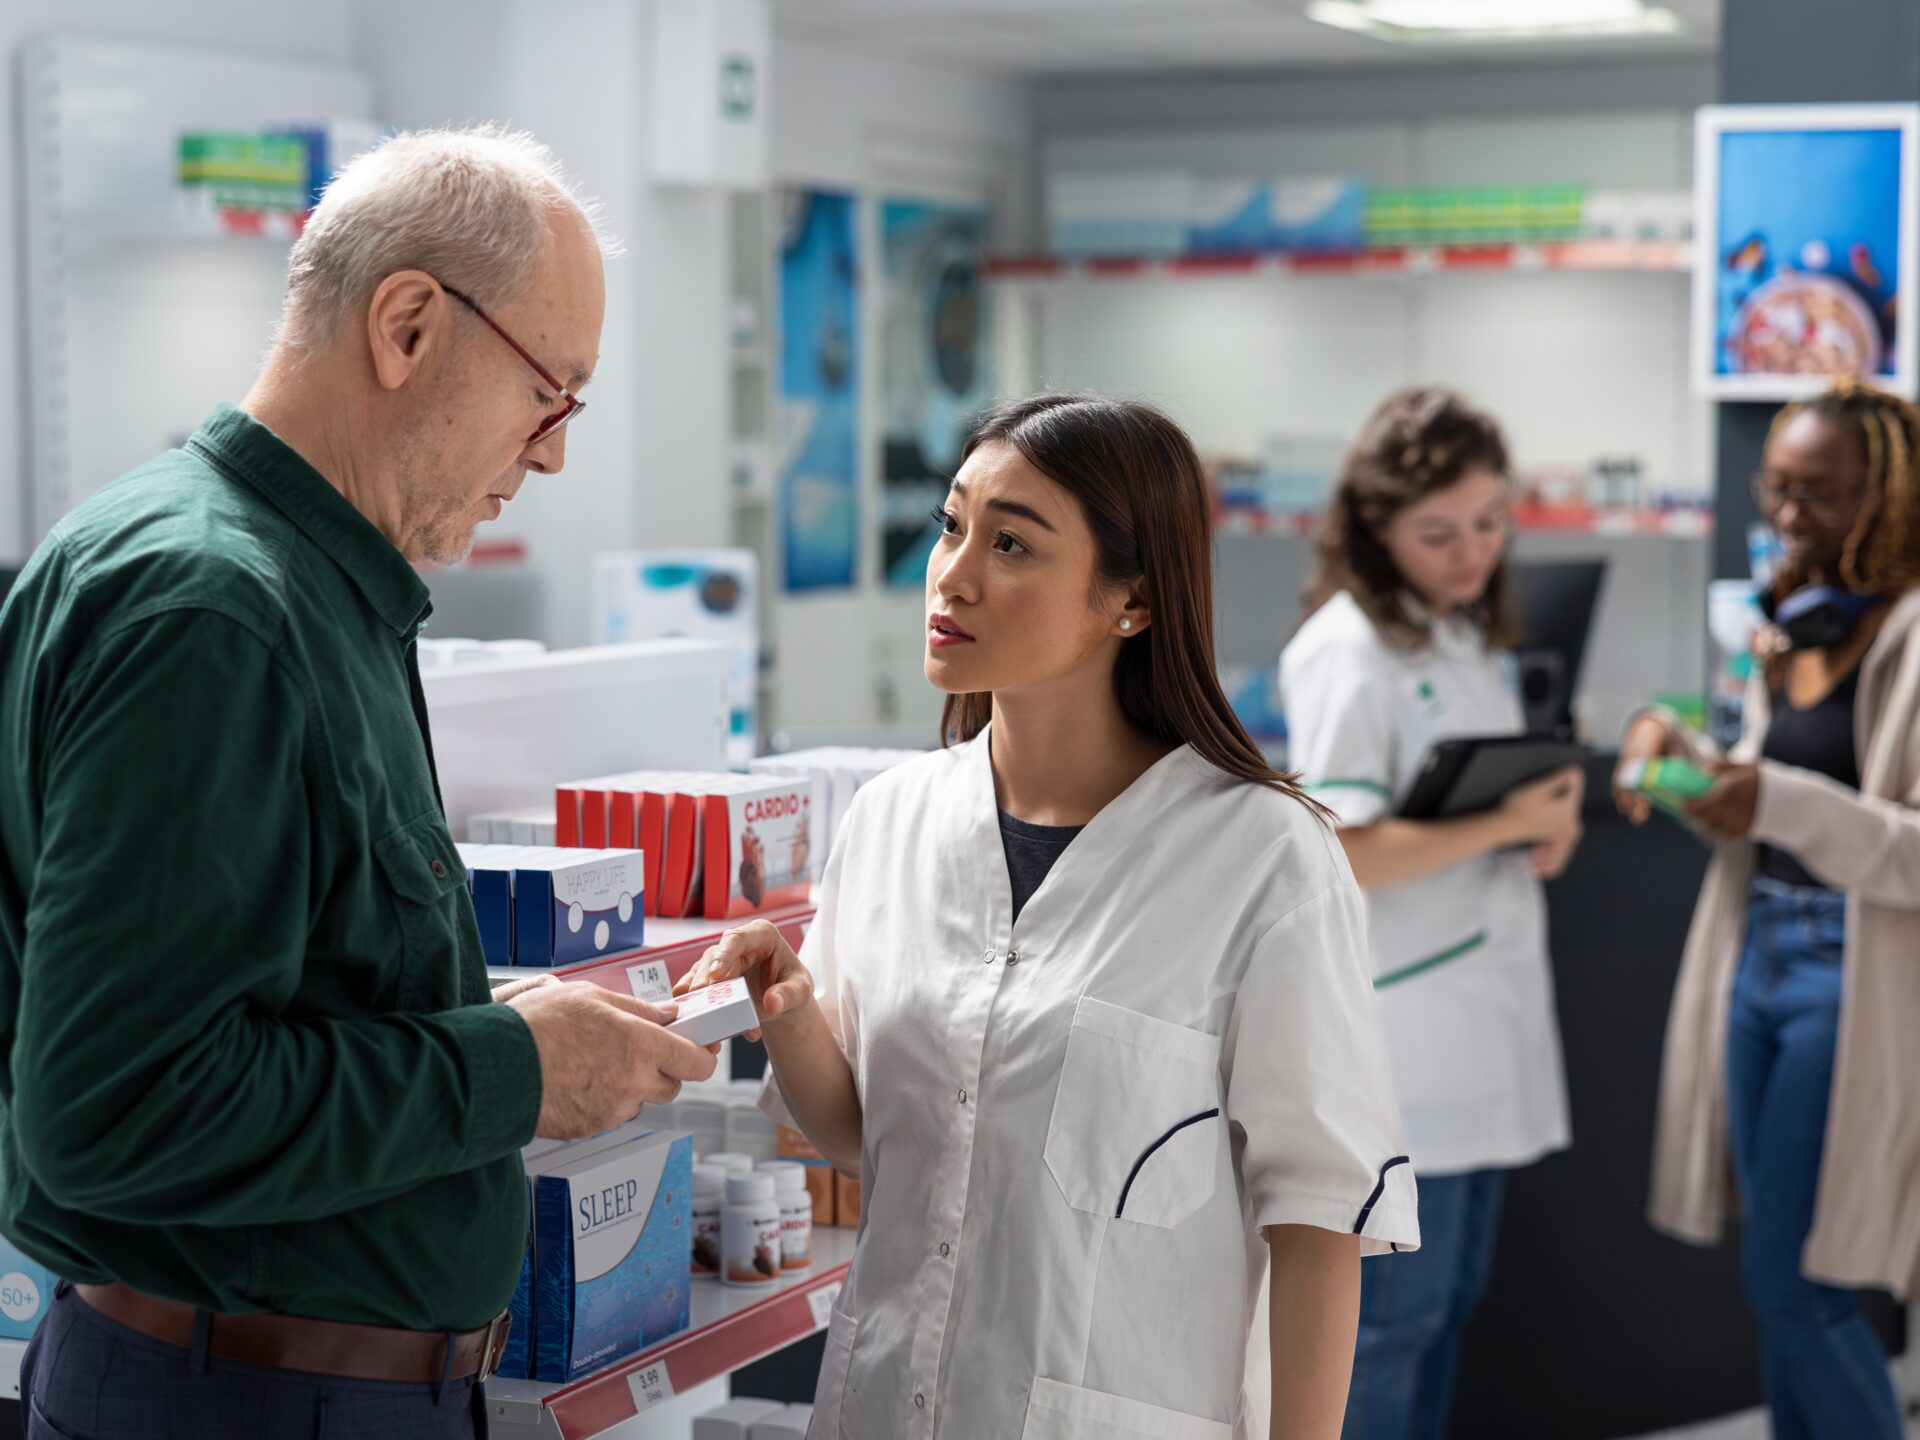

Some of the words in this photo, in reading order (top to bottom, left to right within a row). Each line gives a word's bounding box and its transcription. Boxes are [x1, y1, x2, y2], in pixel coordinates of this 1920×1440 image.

[744, 793, 799, 823] CARDIO
[566, 868, 601, 895] HAPPY
[602, 864, 628, 887] LIFE
[638, 967, 659, 985] 7.49
[579, 1179, 637, 1232] SLEEP
[2, 1287, 34, 1307] 50+
[639, 1368, 660, 1390] 3.99
